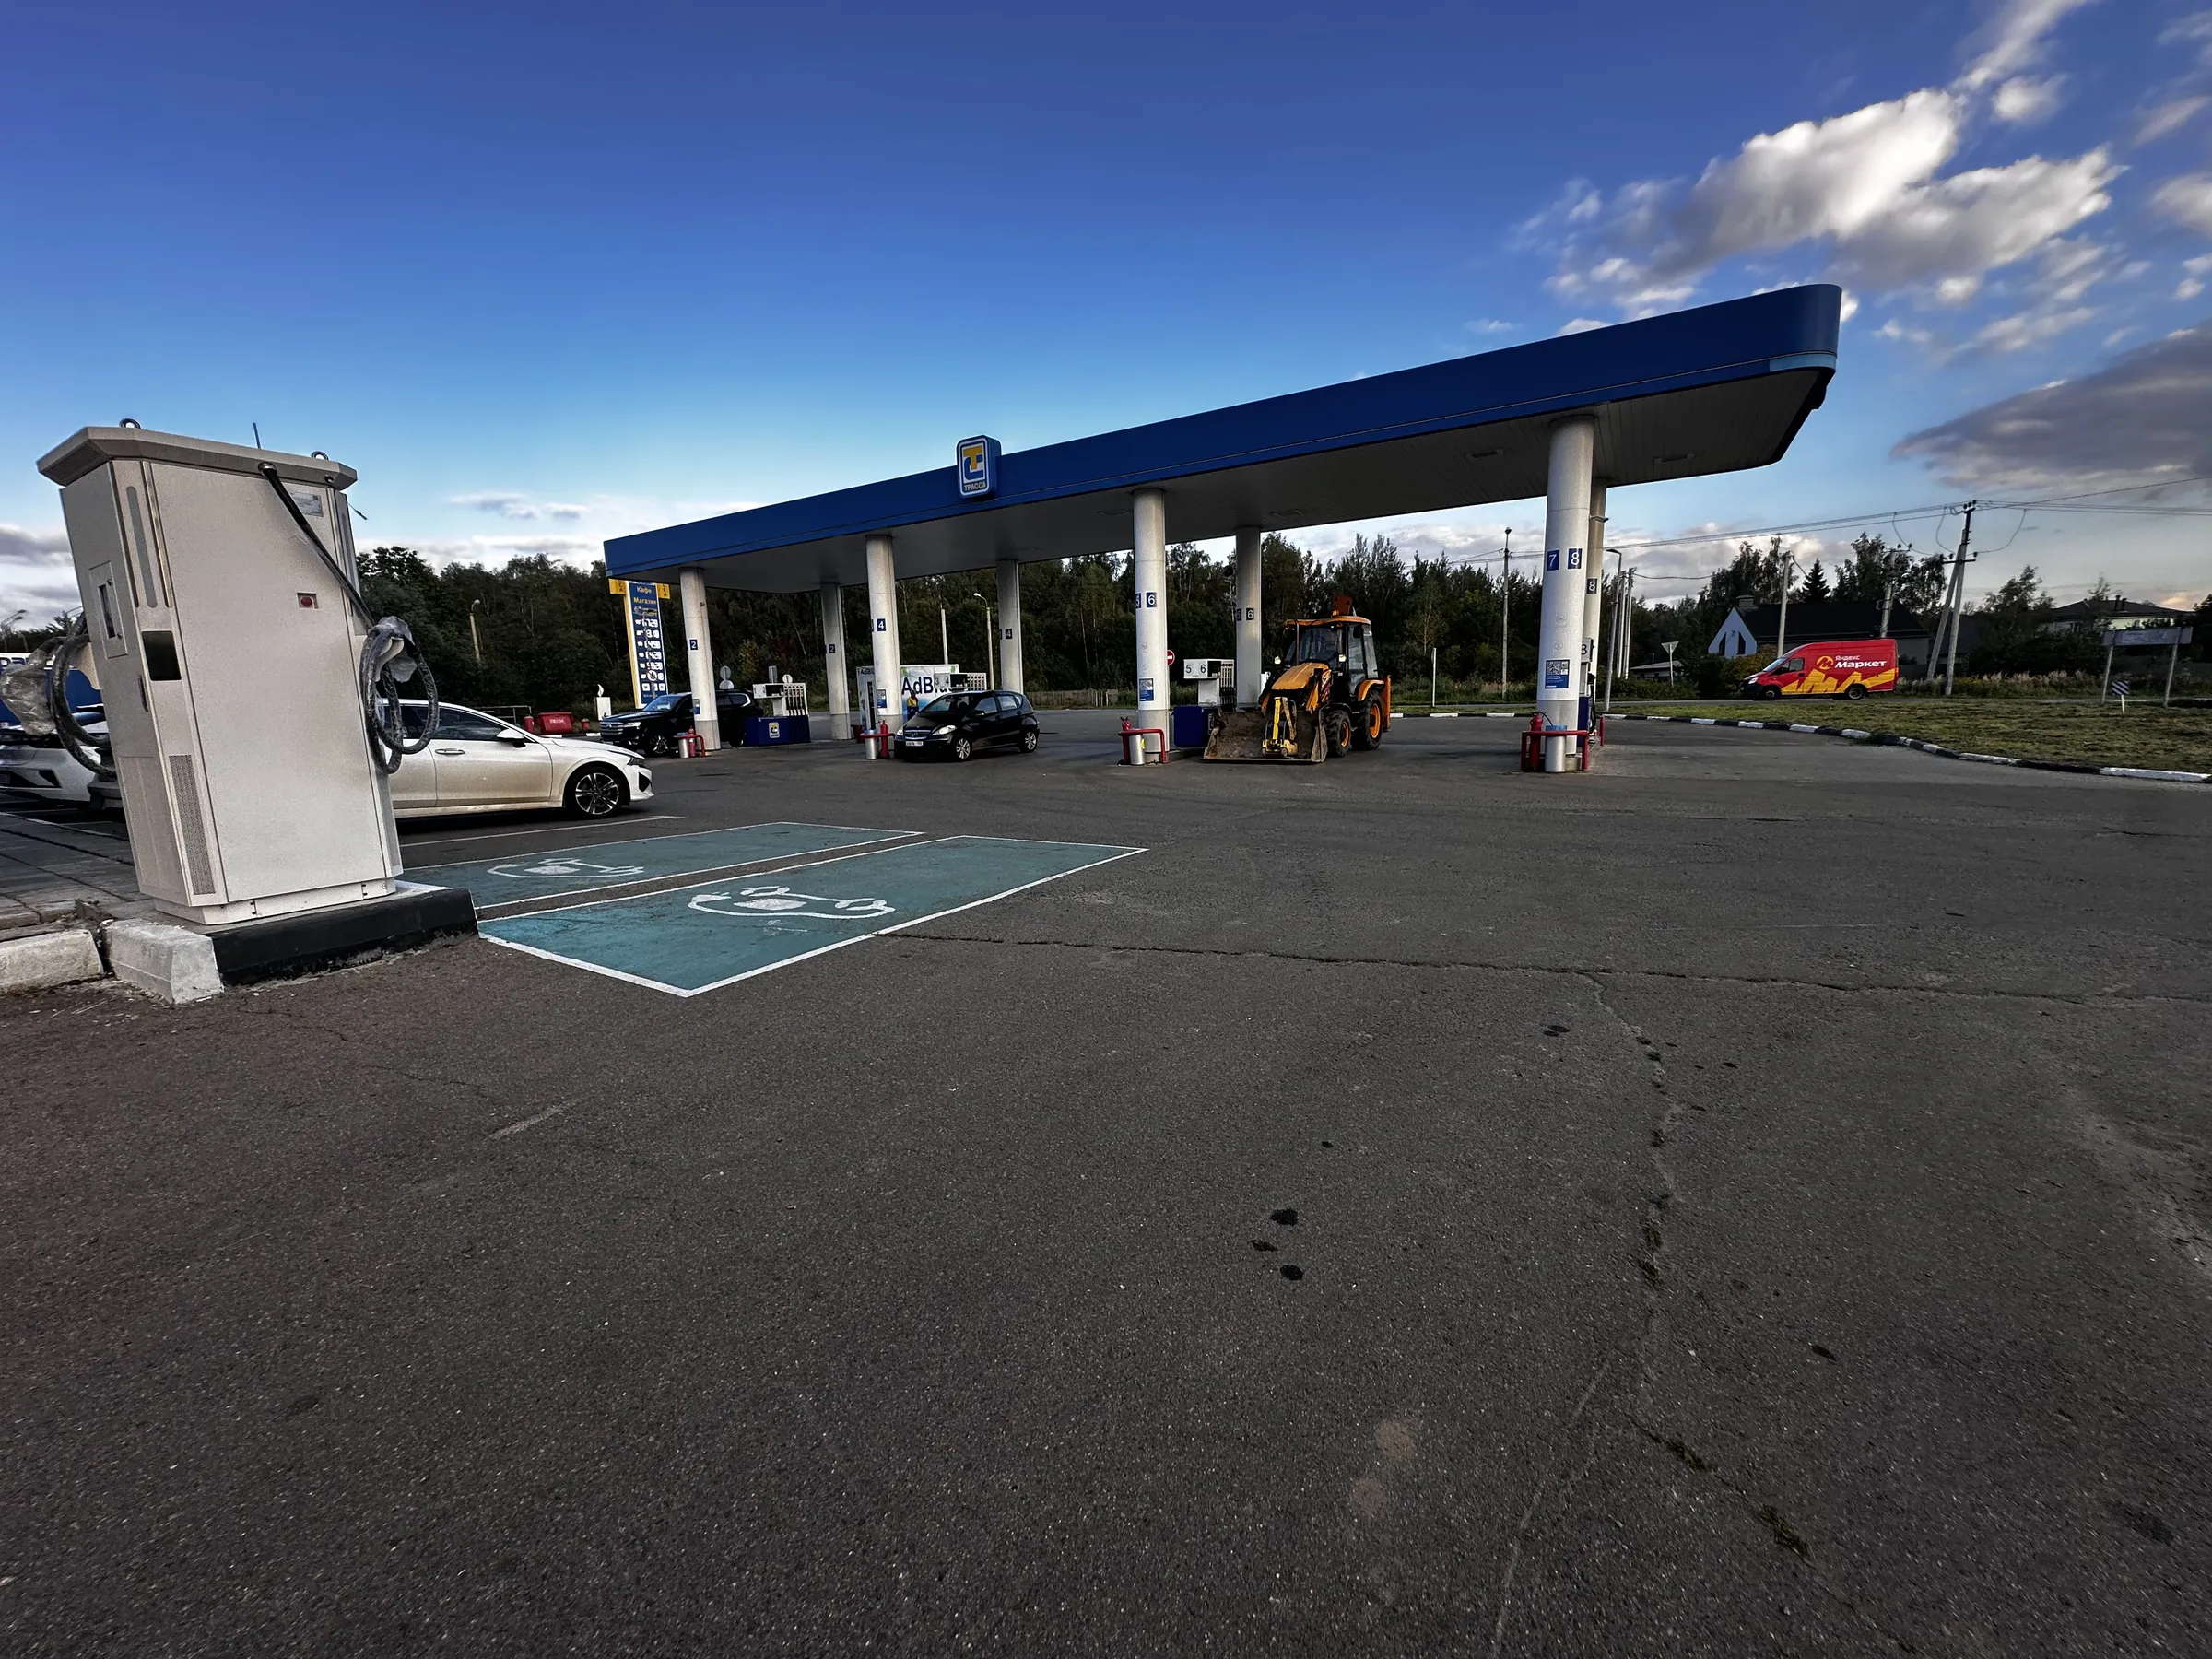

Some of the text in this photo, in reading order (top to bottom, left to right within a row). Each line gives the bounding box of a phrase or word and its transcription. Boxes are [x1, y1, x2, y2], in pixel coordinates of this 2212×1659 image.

[964, 481, 987, 490] ТРАССА
[1549, 554, 1556, 567] 7
[1571, 551, 1579, 566] 8
[1589, 581, 1595, 591] 8
[1147, 594, 1155, 606] 6
[1247, 609, 1253, 618] 6
[877, 620, 885, 629] 4
[1006, 629, 1012, 638] 4
[1185, 664, 1206, 674] 5 6
[935, 677, 950, 686] 3 4
